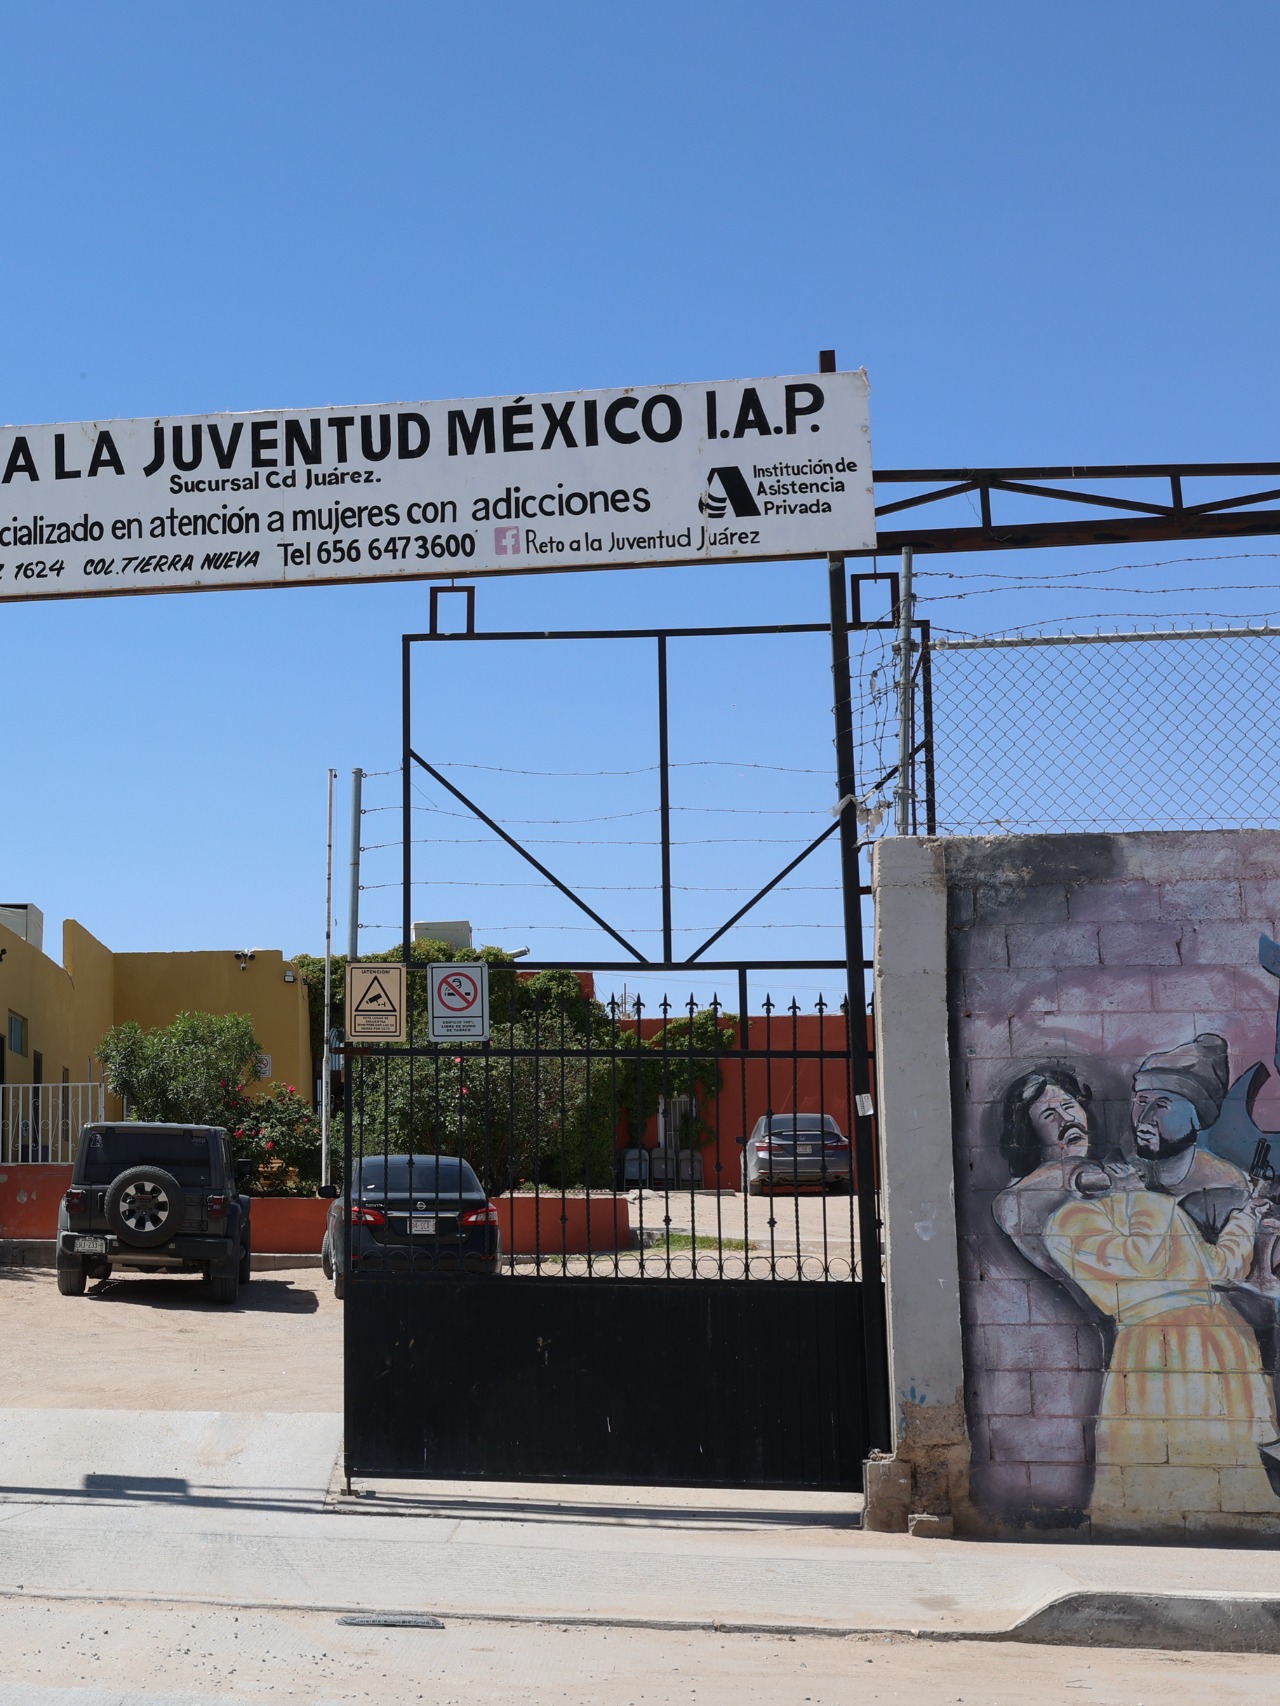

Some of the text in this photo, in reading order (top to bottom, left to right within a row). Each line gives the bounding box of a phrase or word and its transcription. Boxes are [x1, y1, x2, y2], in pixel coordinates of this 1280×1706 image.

[2, 437, 39, 484] A
[55, 431, 125, 480] LA
[143, 413, 430, 477] JUVENTUD
[448, 394, 682, 456] MÉXICO
[706, 383, 824, 439] I.A.P.
[170, 467, 381, 494] Sucursal Cd Juárez.
[753, 457, 857, 480] Institución de
[757, 477, 845, 496] Asistencia
[112, 518, 142, 540] en
[150, 504, 259, 538] atención
[267, 511, 284, 532] a
[293, 501, 400, 535] mujeres
[407, 501, 456, 524] con
[472, 483, 650, 521] adicciones
[764, 499, 831, 515] Privada
[277, 533, 475, 566] Tel 656 647 3600
[526, 526, 760, 554] Reto a la Juventud Juárez
[15, 560, 64, 580] 1624
[201, 551, 260, 570] NUEVA
